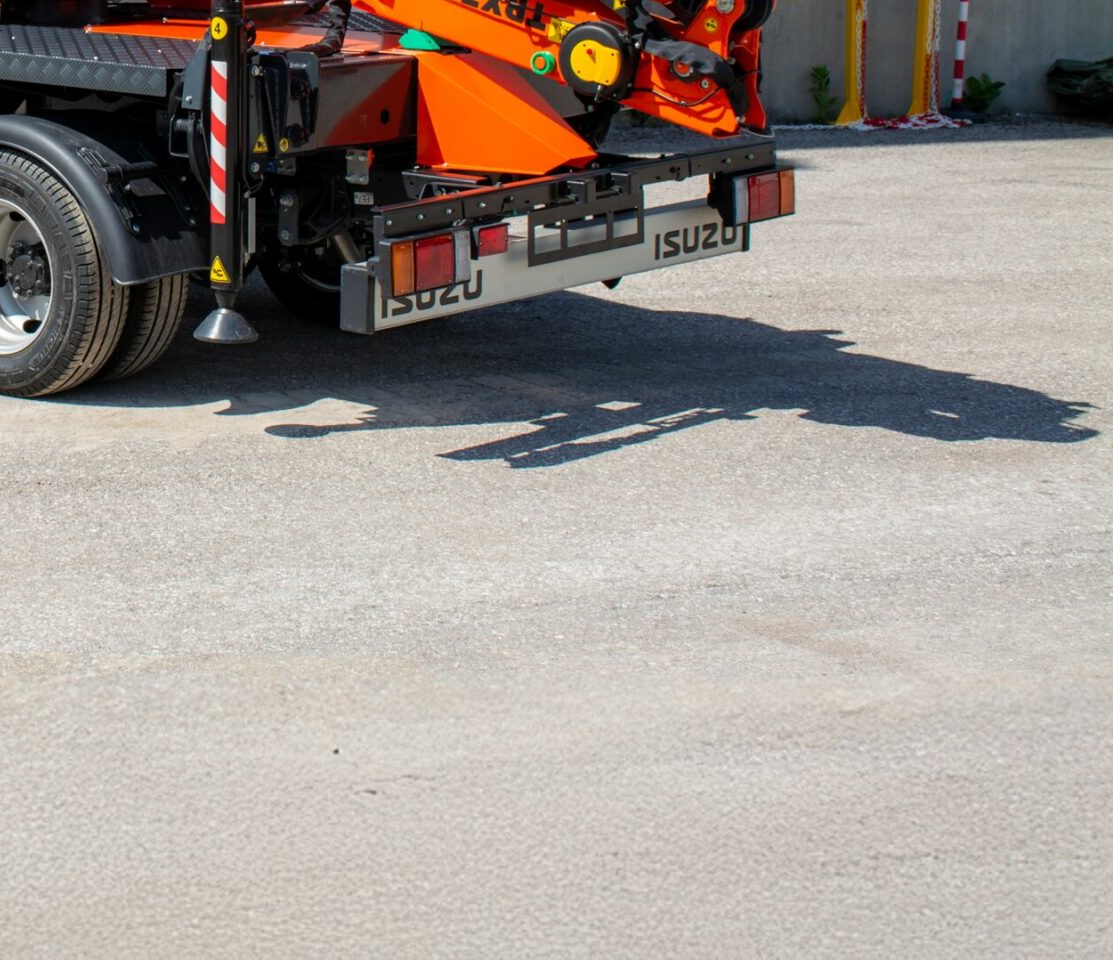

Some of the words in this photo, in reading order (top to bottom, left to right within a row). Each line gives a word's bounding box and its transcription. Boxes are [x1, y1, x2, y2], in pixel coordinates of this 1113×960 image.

[214, 22, 221, 35] 4
[654, 222, 737, 260] ISUZU
[381, 269, 482, 319] ISUZU
